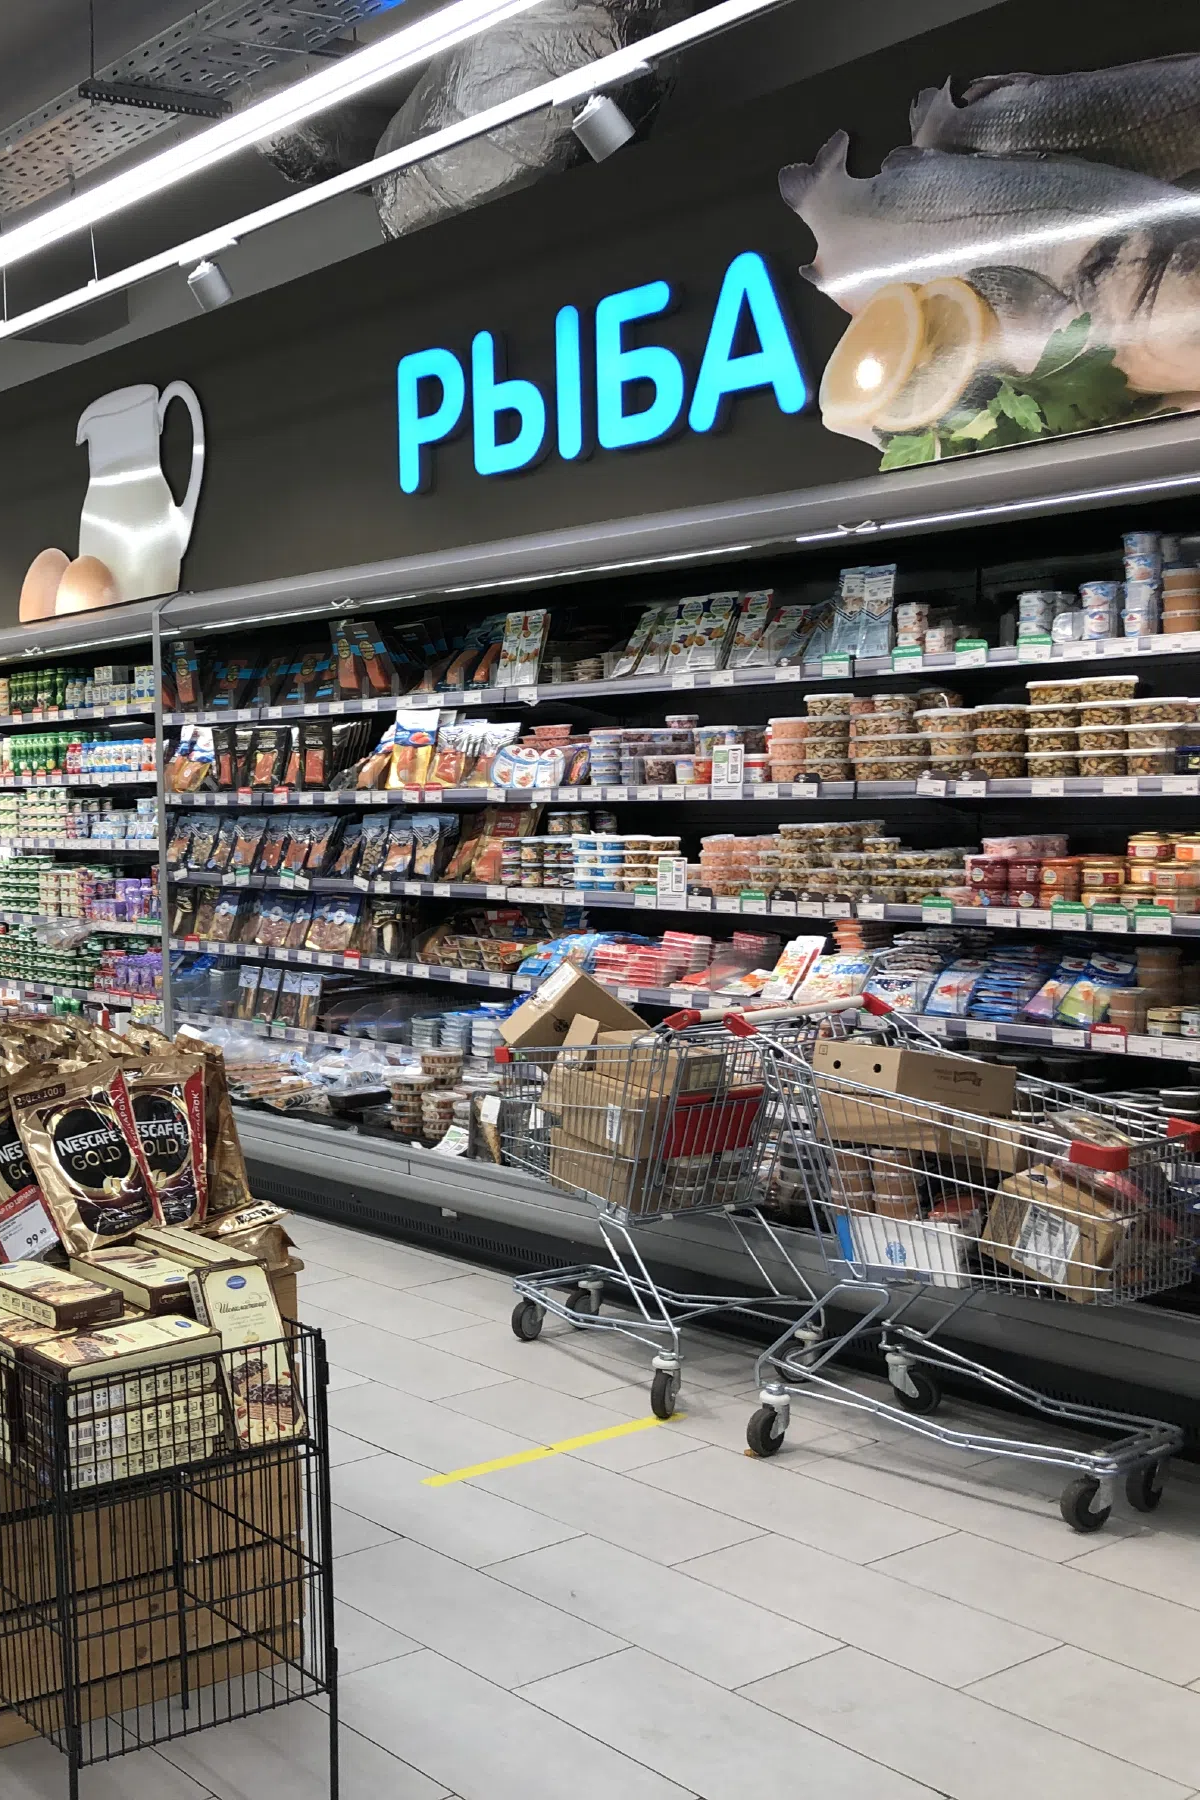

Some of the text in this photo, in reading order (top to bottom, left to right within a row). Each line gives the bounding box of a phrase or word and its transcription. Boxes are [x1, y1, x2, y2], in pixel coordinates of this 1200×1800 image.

[397, 251, 807, 494] РЫБА
[71, 1145, 123, 1171] GOLD
[143, 1138, 180, 1156] OLD
[26, 1233, 39, 1248] 99
